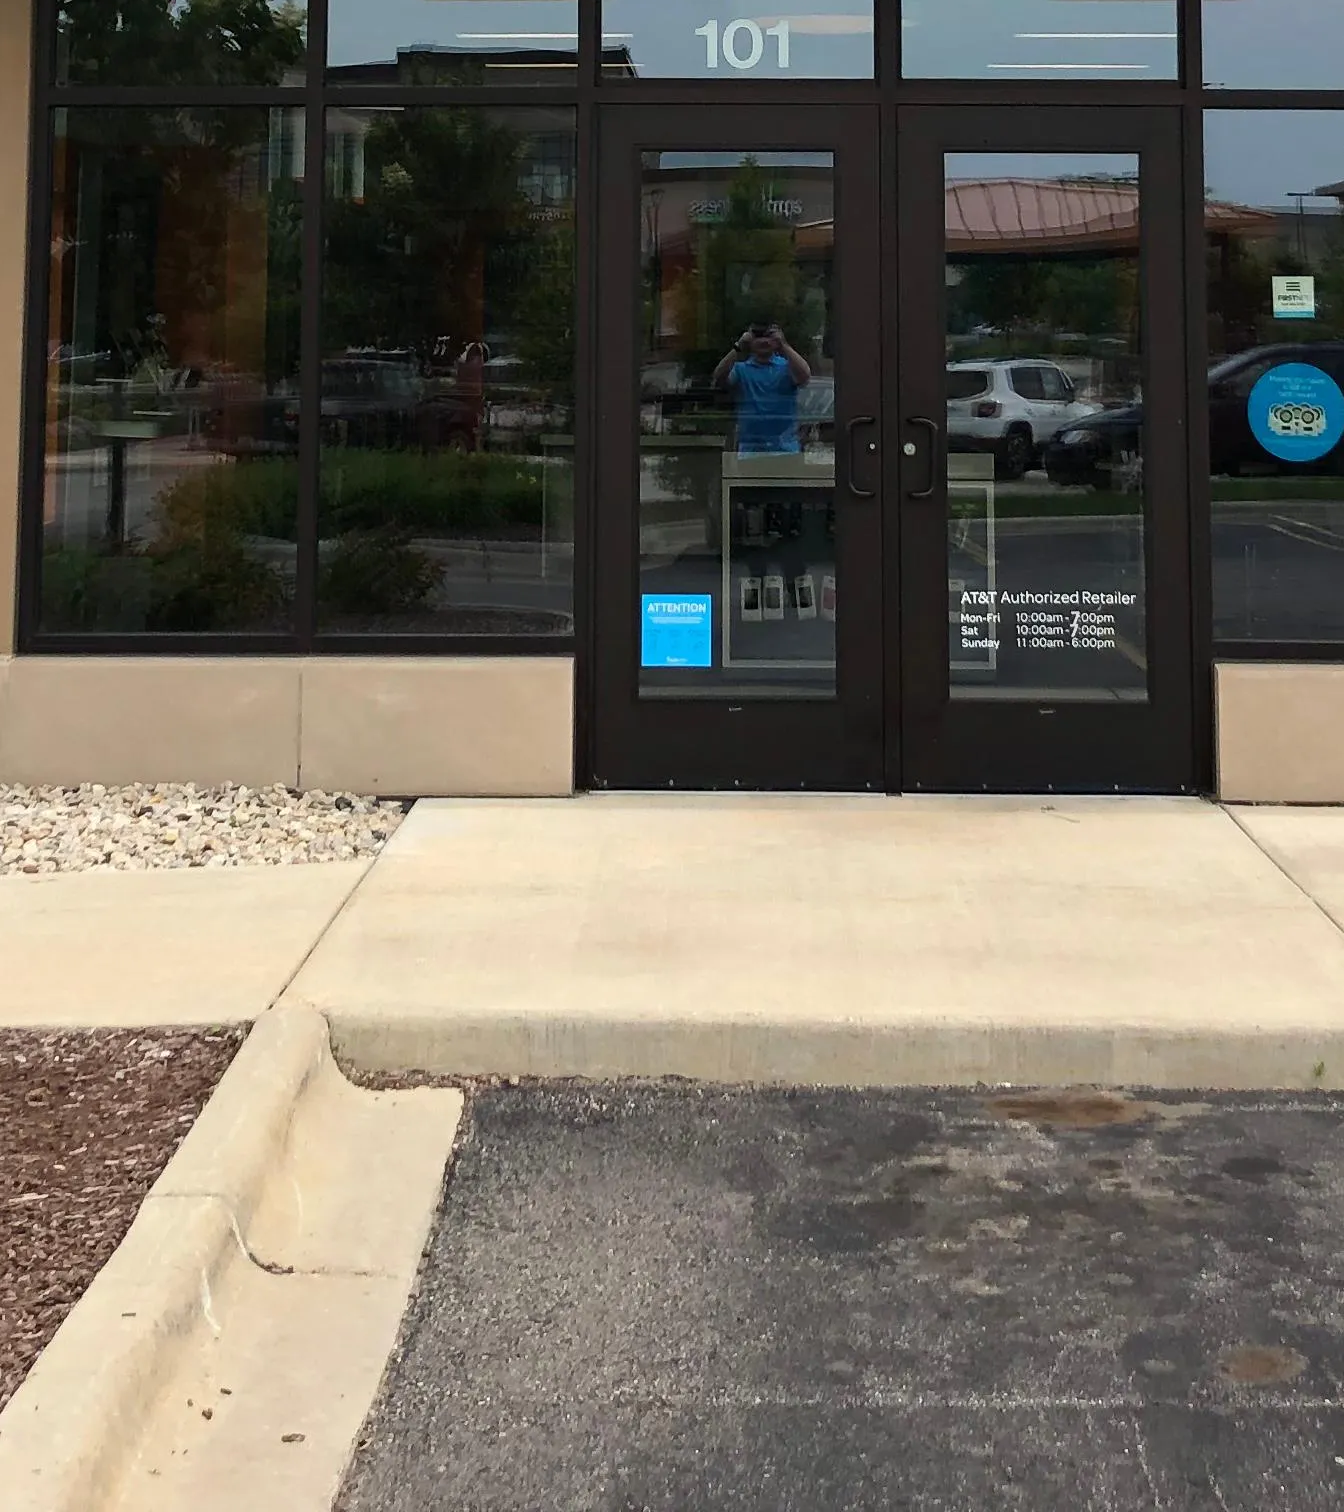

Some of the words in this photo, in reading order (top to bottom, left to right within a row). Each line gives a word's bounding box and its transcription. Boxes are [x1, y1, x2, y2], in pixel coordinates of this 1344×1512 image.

[694, 18, 790, 70] 101
[960, 590, 997, 605] AT&T
[1000, 590, 1080, 605] Authorized
[1082, 591, 1137, 605] Retailer
[647, 602, 707, 614] ATTENTION
[960, 612, 1001, 623] Mon-Fri
[1016, 612, 1064, 623] 10:00am
[960, 625, 979, 635] Sat
[1016, 625, 1064, 635] 10:00am
[961, 638, 1000, 649] Sunday
[1016, 638, 1064, 648] 11:00am
[1071, 638, 1116, 649] 6:00pm
